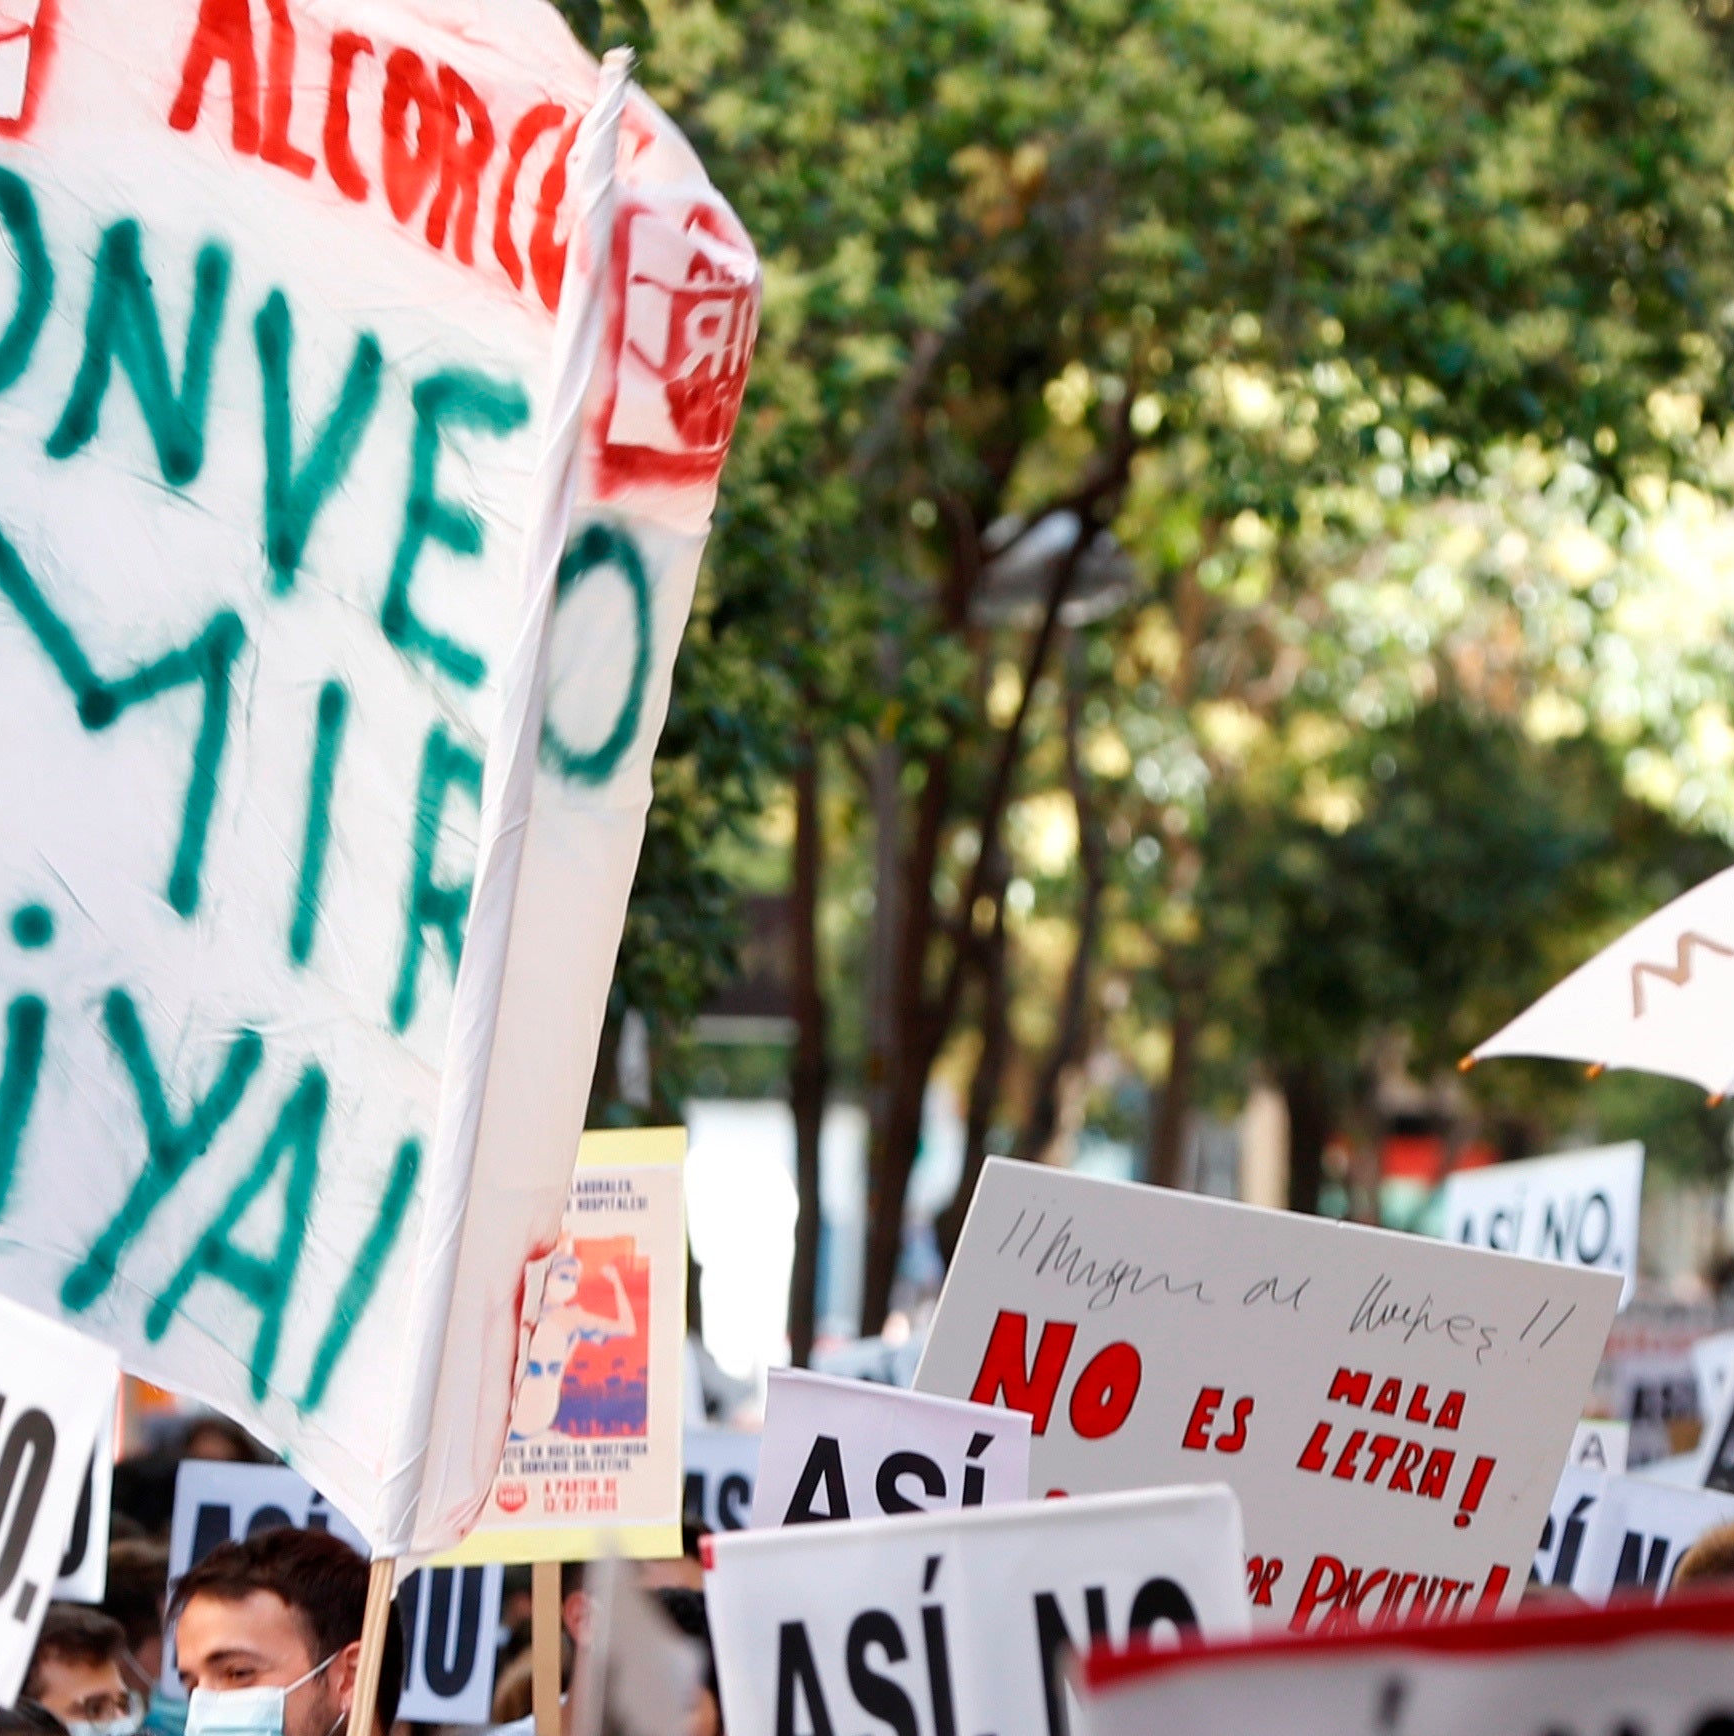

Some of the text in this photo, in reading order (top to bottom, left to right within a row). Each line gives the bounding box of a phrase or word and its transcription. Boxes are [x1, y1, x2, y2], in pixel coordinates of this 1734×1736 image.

[1538, 1190, 1623, 1266] NO.
[970, 1308, 1255, 1453] NO ES
[1327, 1366, 1467, 1431] MALA
[1296, 1421, 1498, 1529] LETRA!
